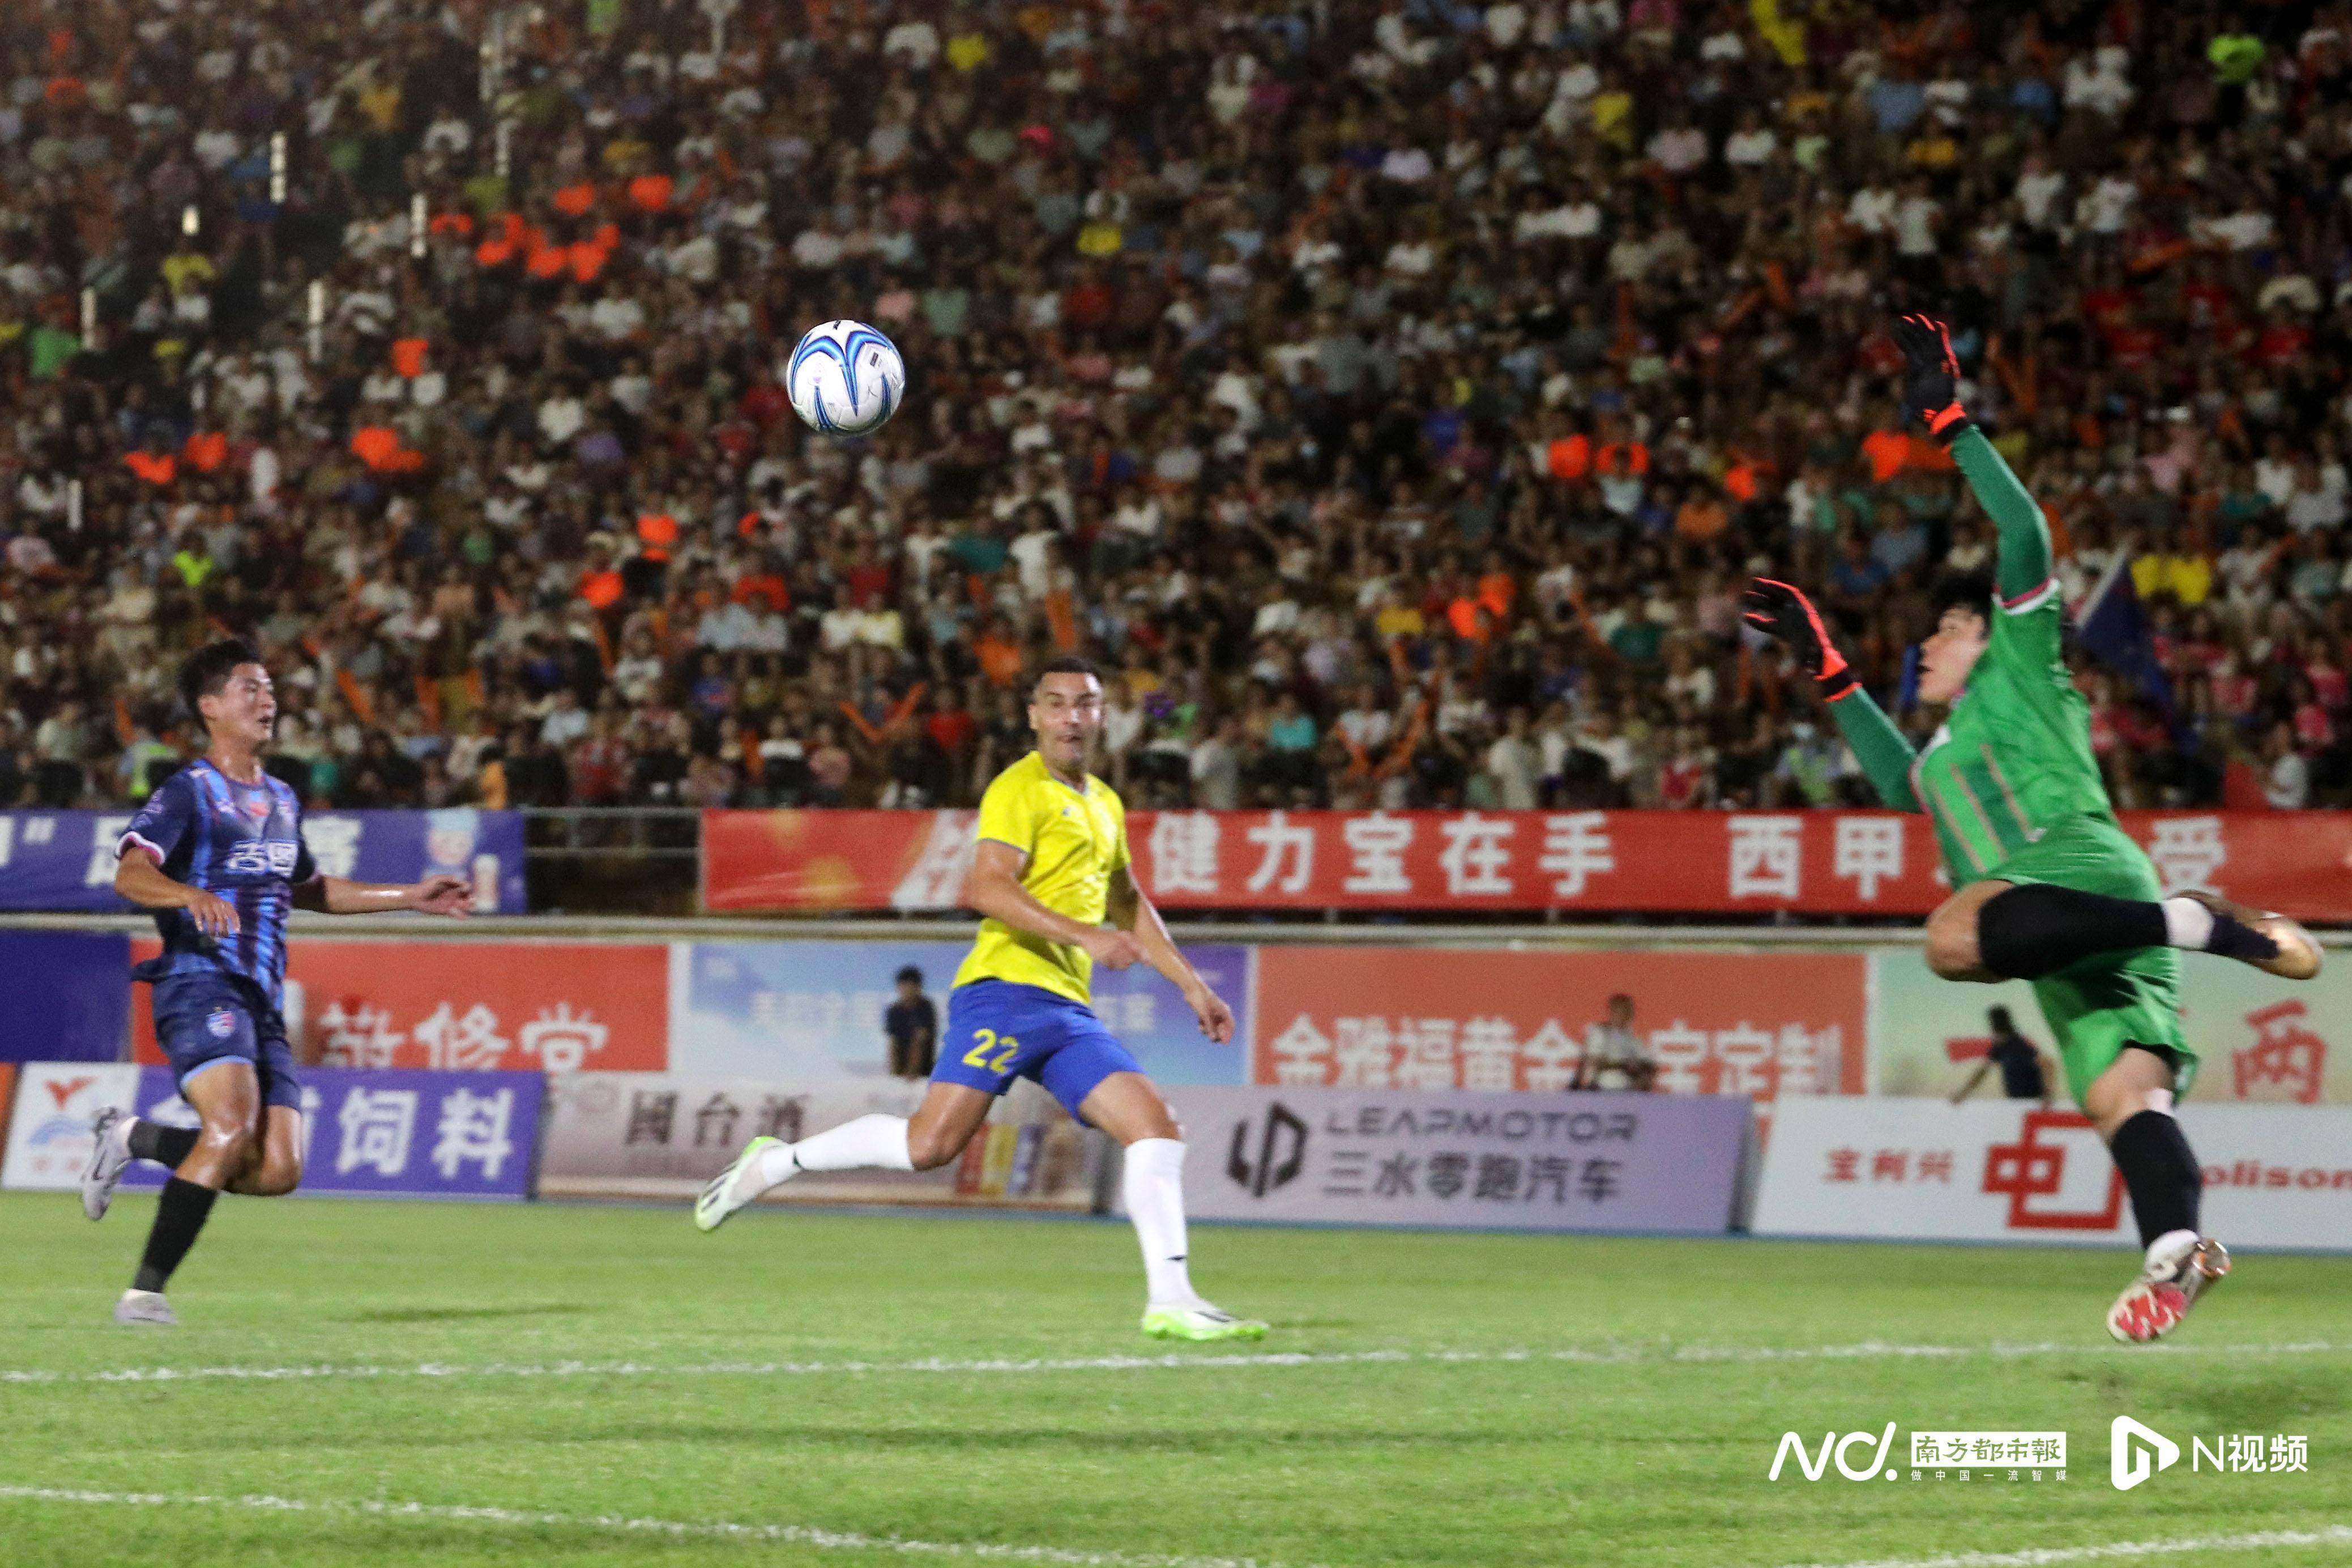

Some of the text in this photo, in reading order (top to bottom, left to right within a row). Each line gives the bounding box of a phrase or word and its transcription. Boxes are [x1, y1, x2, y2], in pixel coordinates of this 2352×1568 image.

[1149, 811, 1613, 896] 健力宝在手
[963, 1028, 1019, 1074] 22
[1272, 1014, 1843, 1094] 金雅福黄金宝定制
[1325, 1108, 1638, 1141] LEAPMOTOR
[1322, 1149, 1624, 1203] 三水零跑汽车
